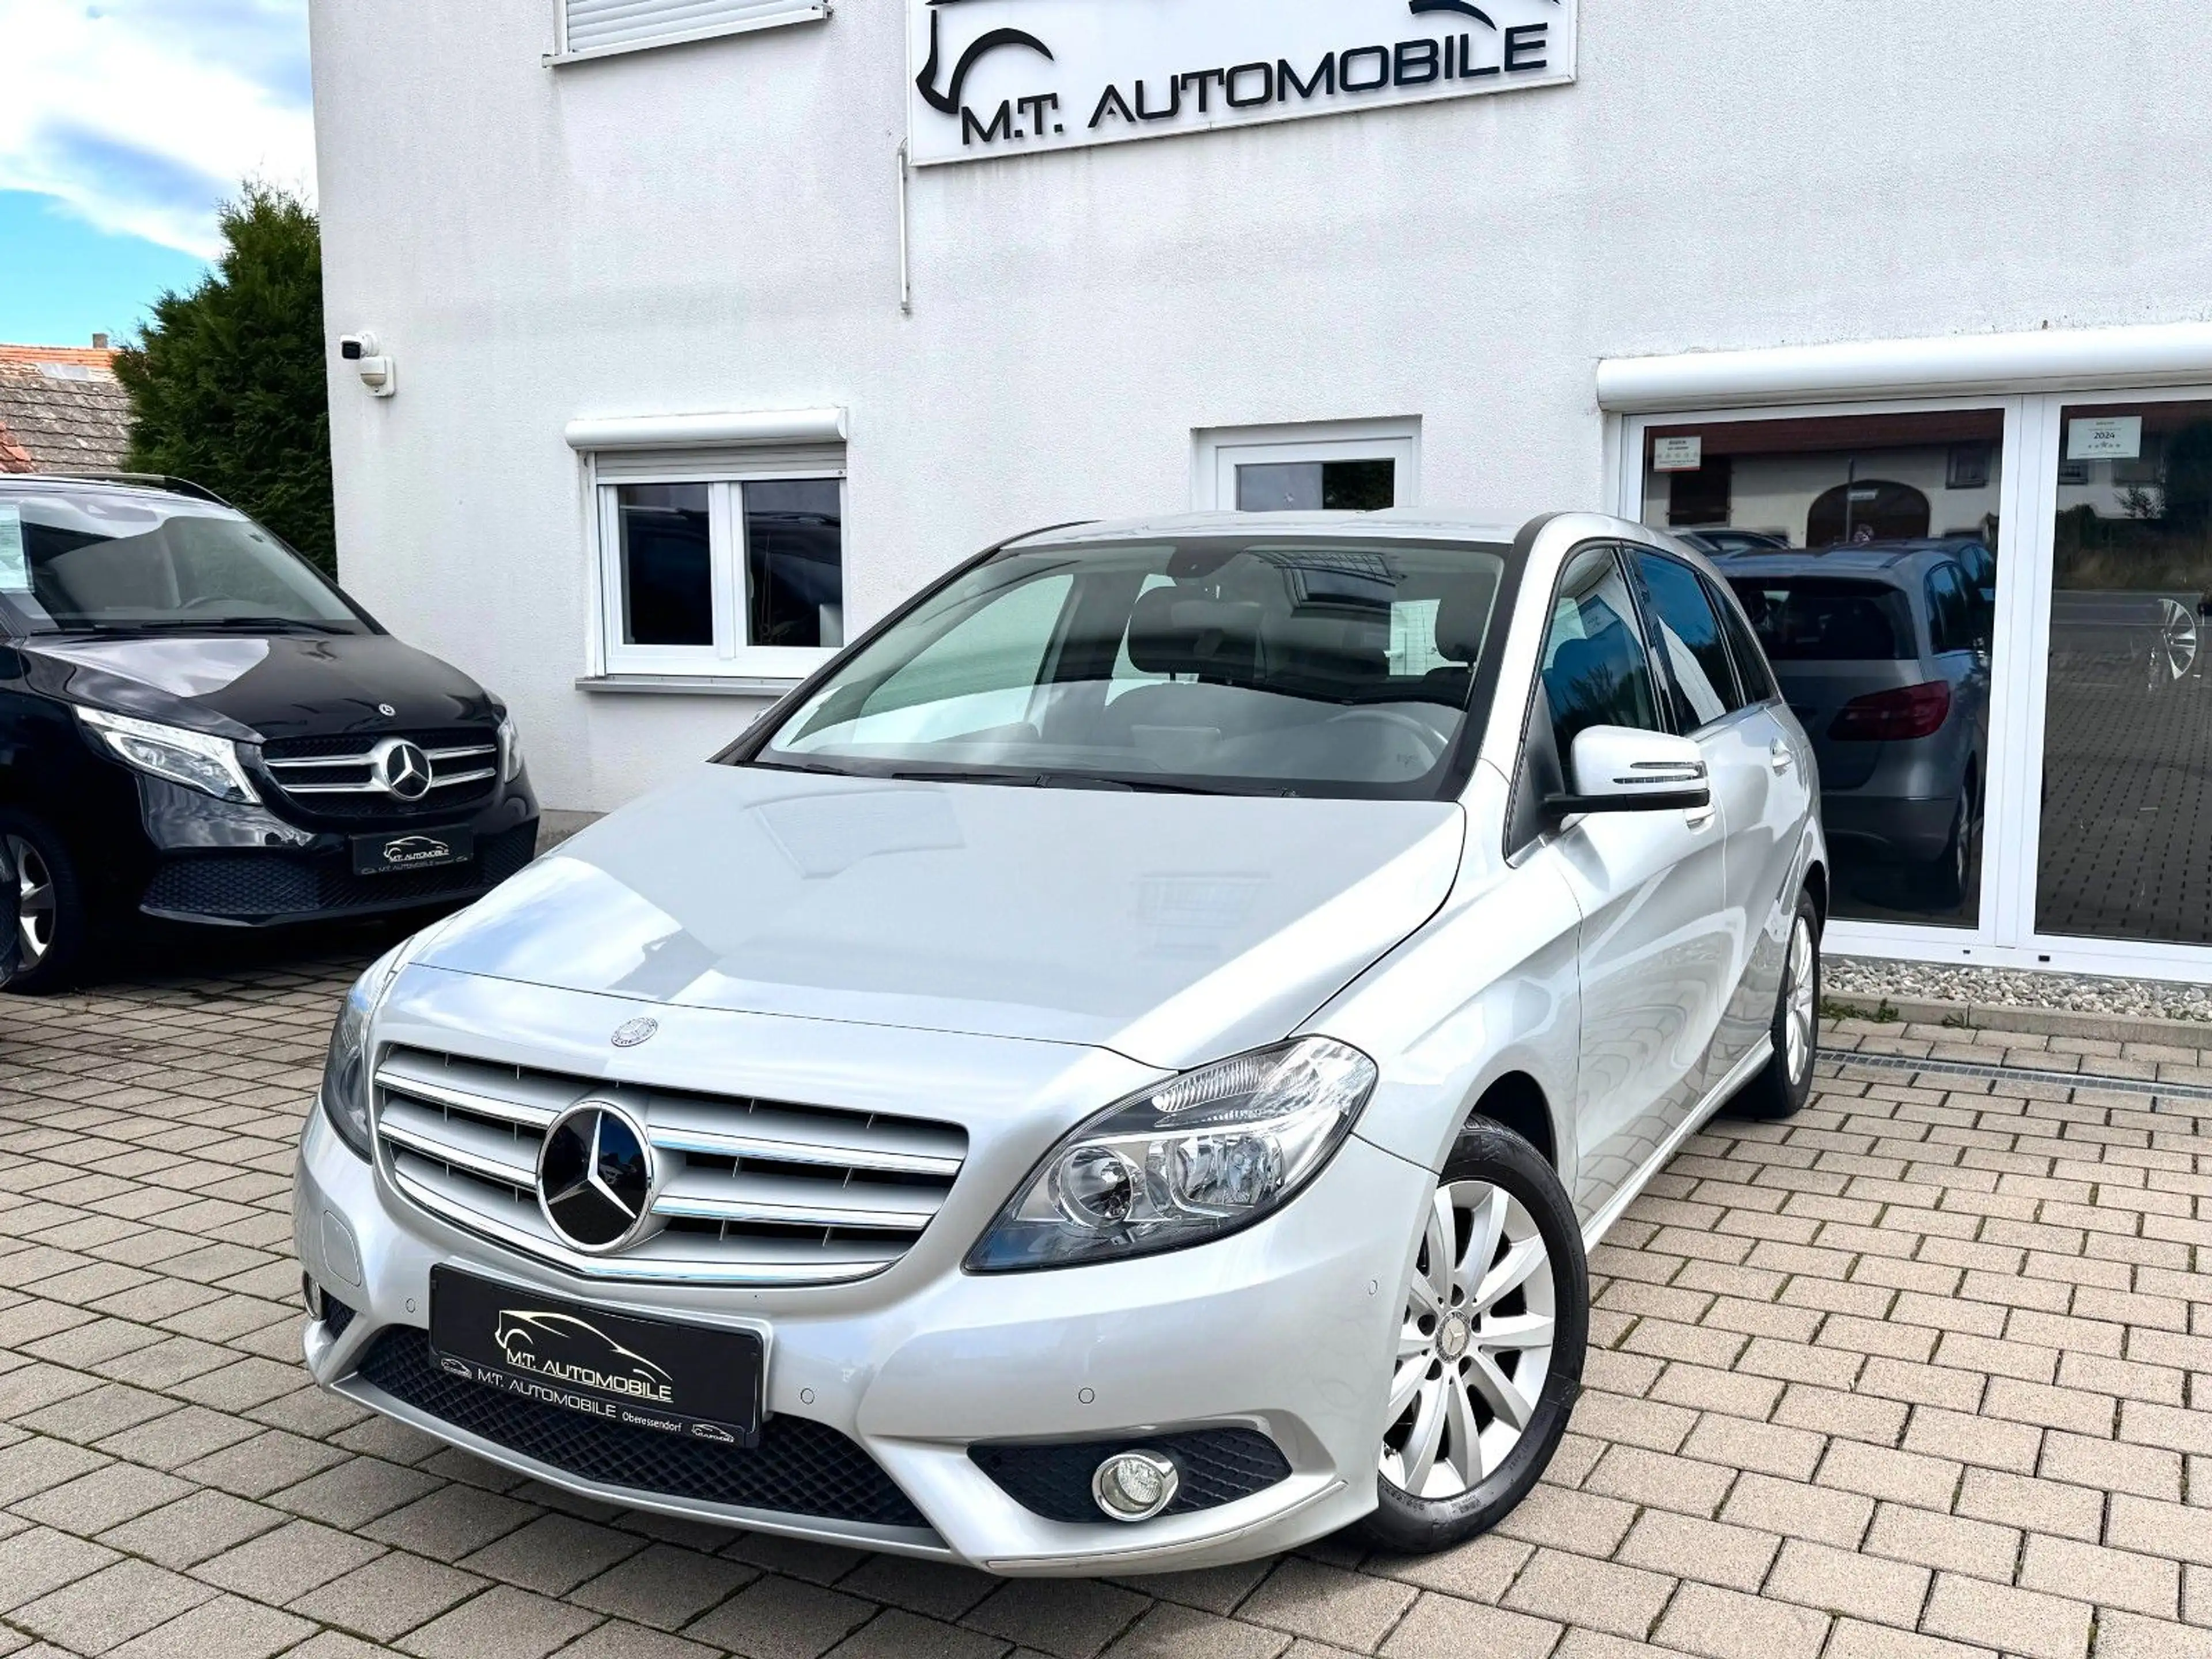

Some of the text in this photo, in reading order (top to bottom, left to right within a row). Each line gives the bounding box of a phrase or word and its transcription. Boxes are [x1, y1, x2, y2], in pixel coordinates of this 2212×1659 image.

[961, 22, 1548, 145] M.T. AUTOMOBILE
[478, 1368, 505, 1387] M.T.
[509, 1380, 616, 1418] AUTOMOBILE
[622, 1411, 682, 1432] Oberessendorf
[507, 1347, 672, 1400] M.T. AUTOMOBILE
